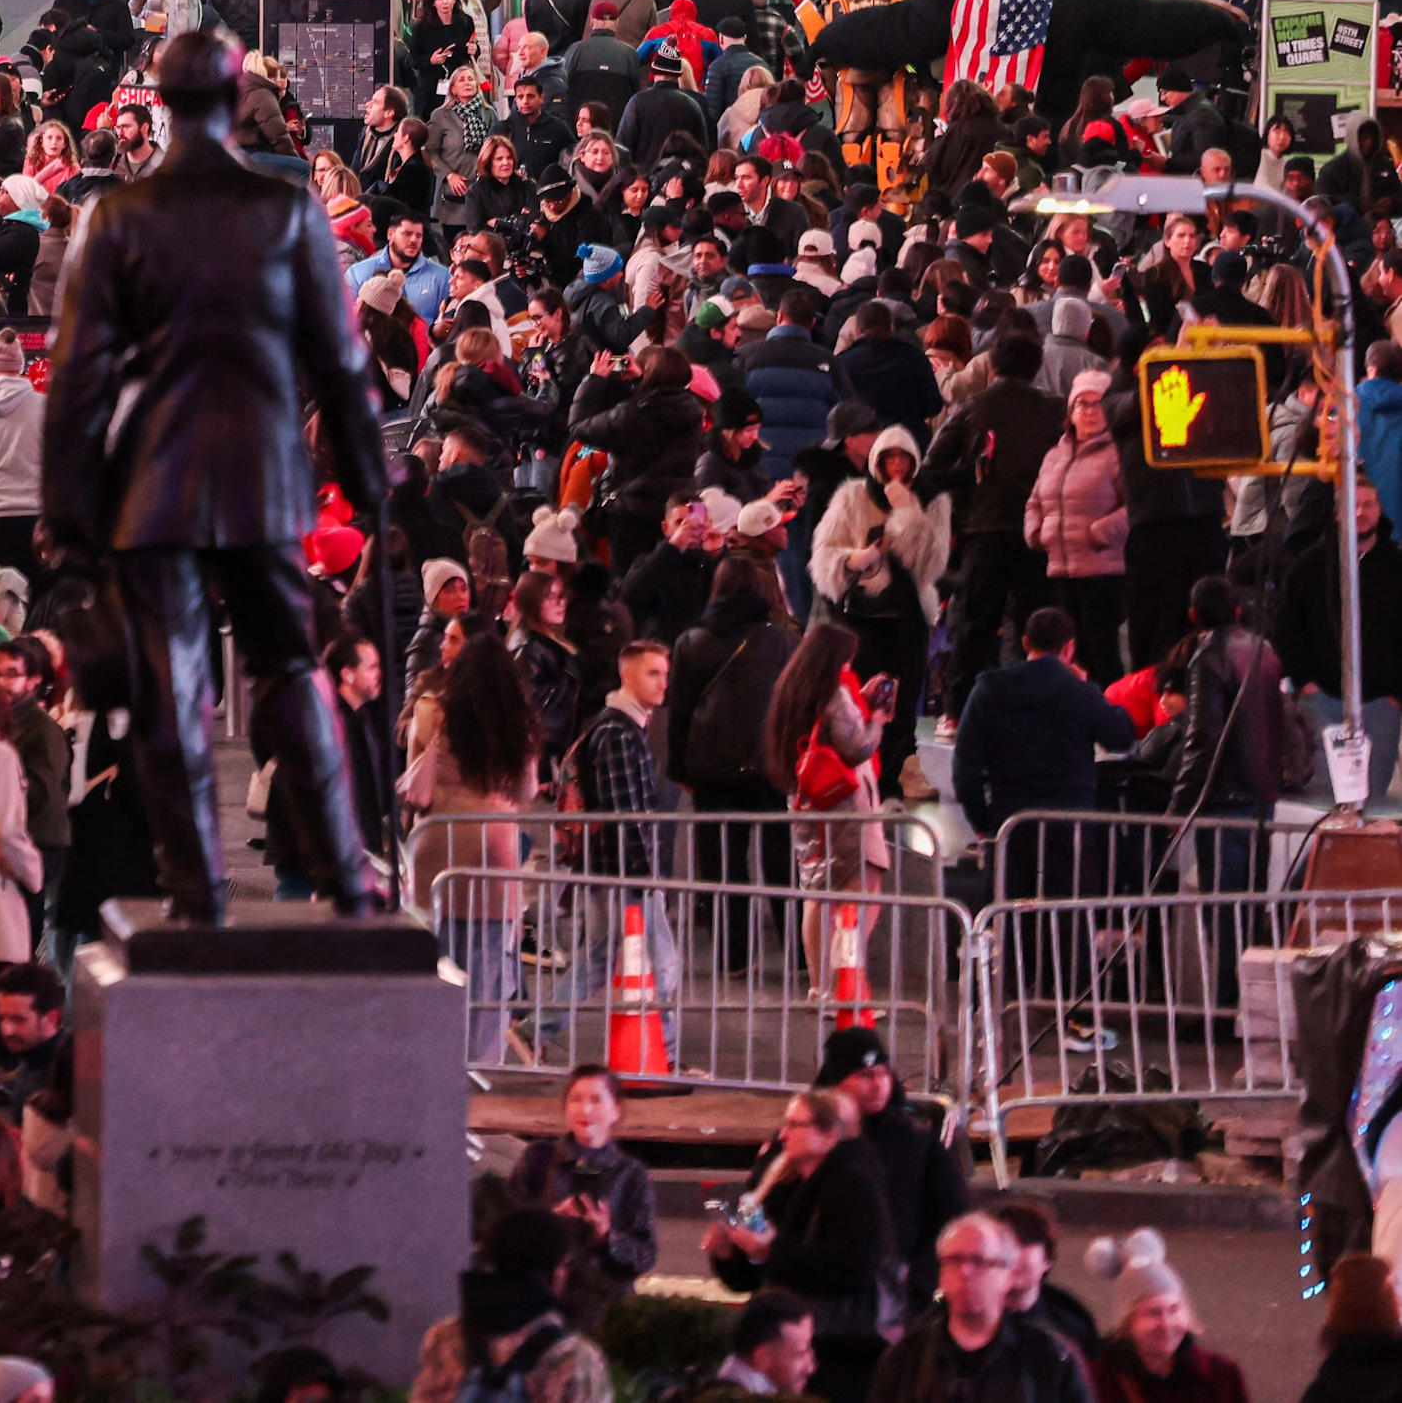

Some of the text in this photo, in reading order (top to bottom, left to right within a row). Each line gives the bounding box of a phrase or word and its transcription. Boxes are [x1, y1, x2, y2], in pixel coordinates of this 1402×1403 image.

[1278, 36, 1325, 54] IN TIMES
[118, 87, 162, 106] CHICA
